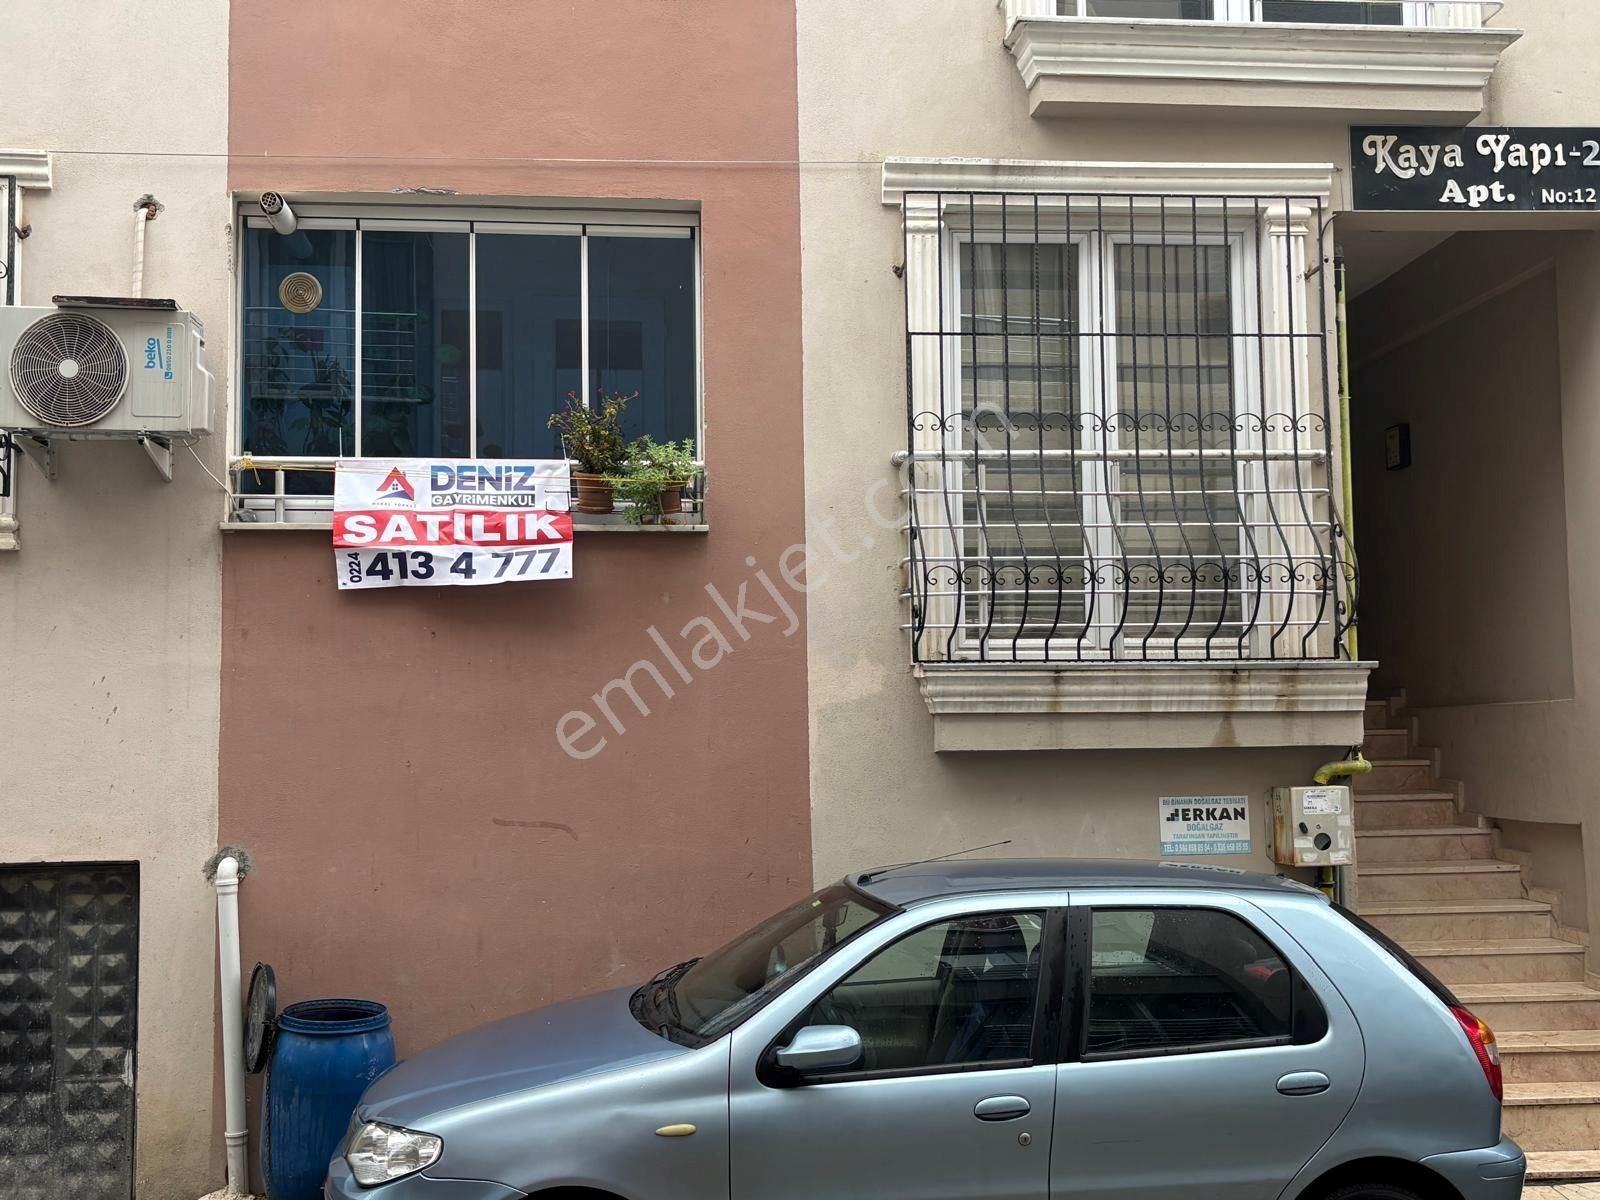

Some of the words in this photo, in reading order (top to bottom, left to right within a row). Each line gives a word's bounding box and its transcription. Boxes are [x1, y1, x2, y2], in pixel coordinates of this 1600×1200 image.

[1362, 134, 1464, 179] Kaya
[1438, 178, 1516, 208] Apt.
[1541, 188, 1597, 203] No:12
[144, 337, 156, 369] beko
[342, 513, 564, 544] SATILIK
[349, 551, 362, 583] 0224
[365, 550, 435, 580] 413
[449, 551, 477, 579] 4
[491, 548, 561, 578] 777
